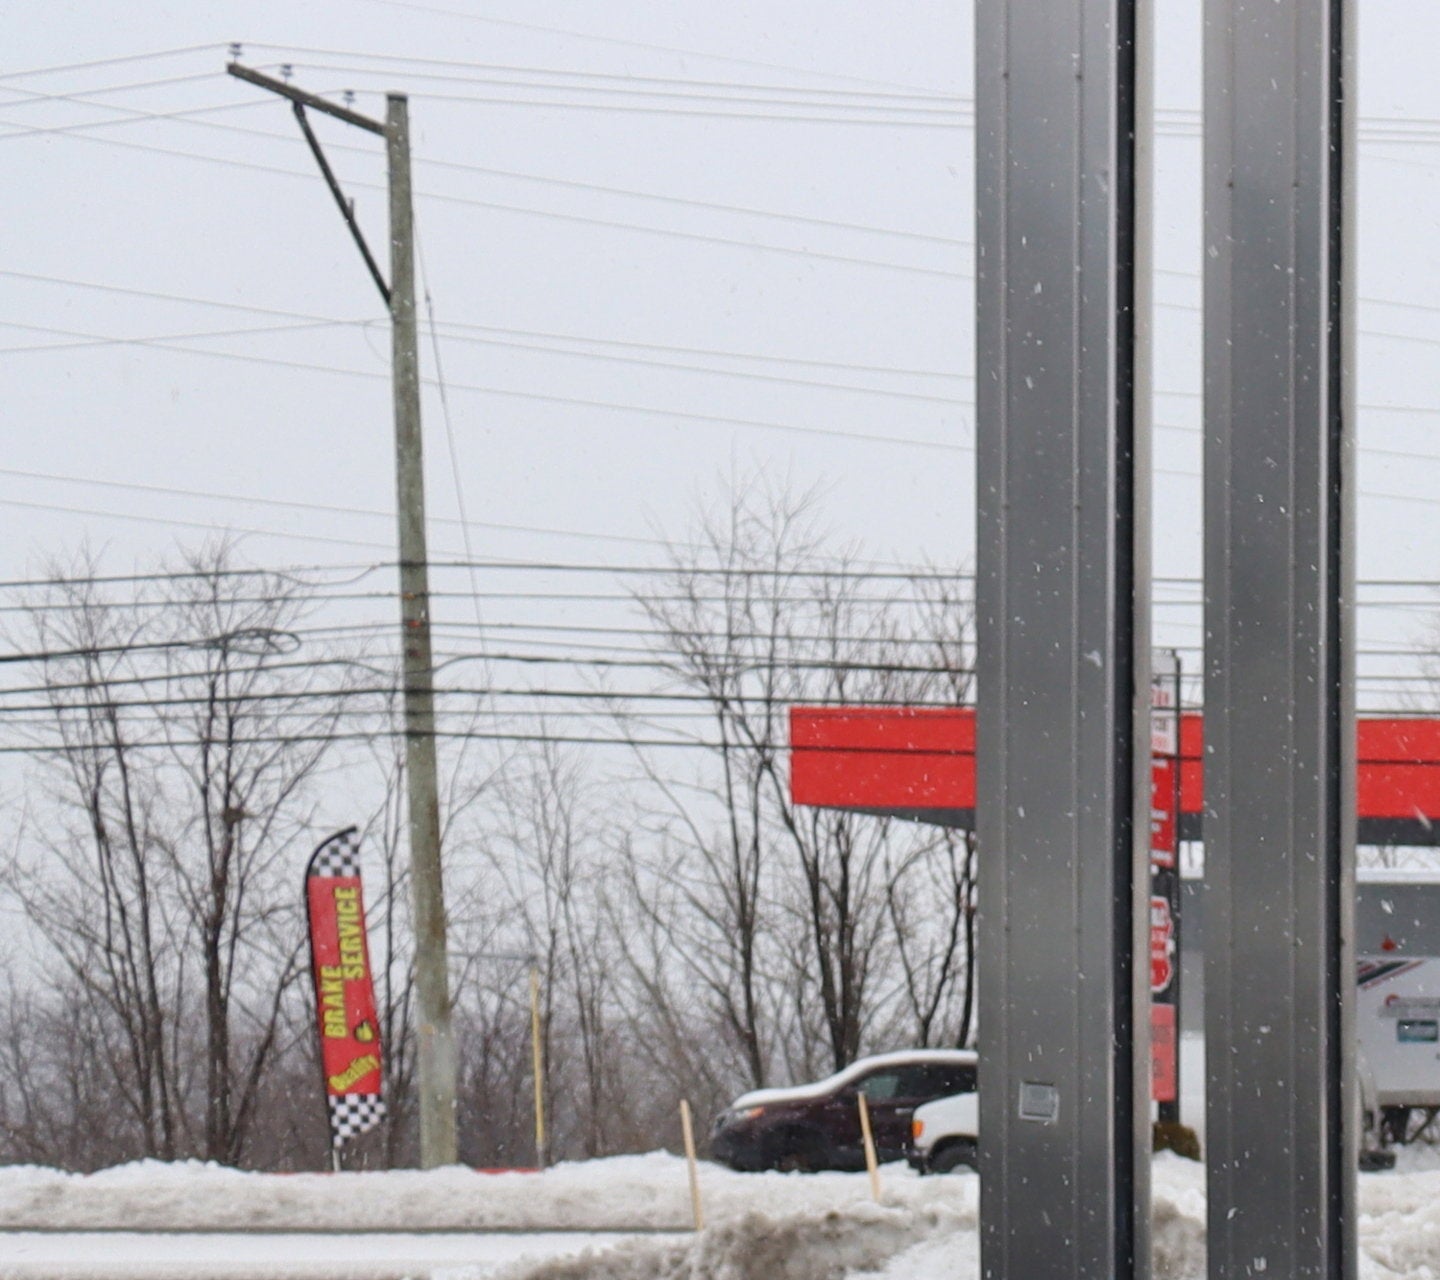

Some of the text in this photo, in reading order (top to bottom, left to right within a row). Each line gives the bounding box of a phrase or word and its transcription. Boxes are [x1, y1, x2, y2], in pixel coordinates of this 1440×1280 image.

[334, 886, 364, 981] SERVICE
[320, 964, 349, 1039] BRAKE
[327, 1053, 381, 1092] Quality
